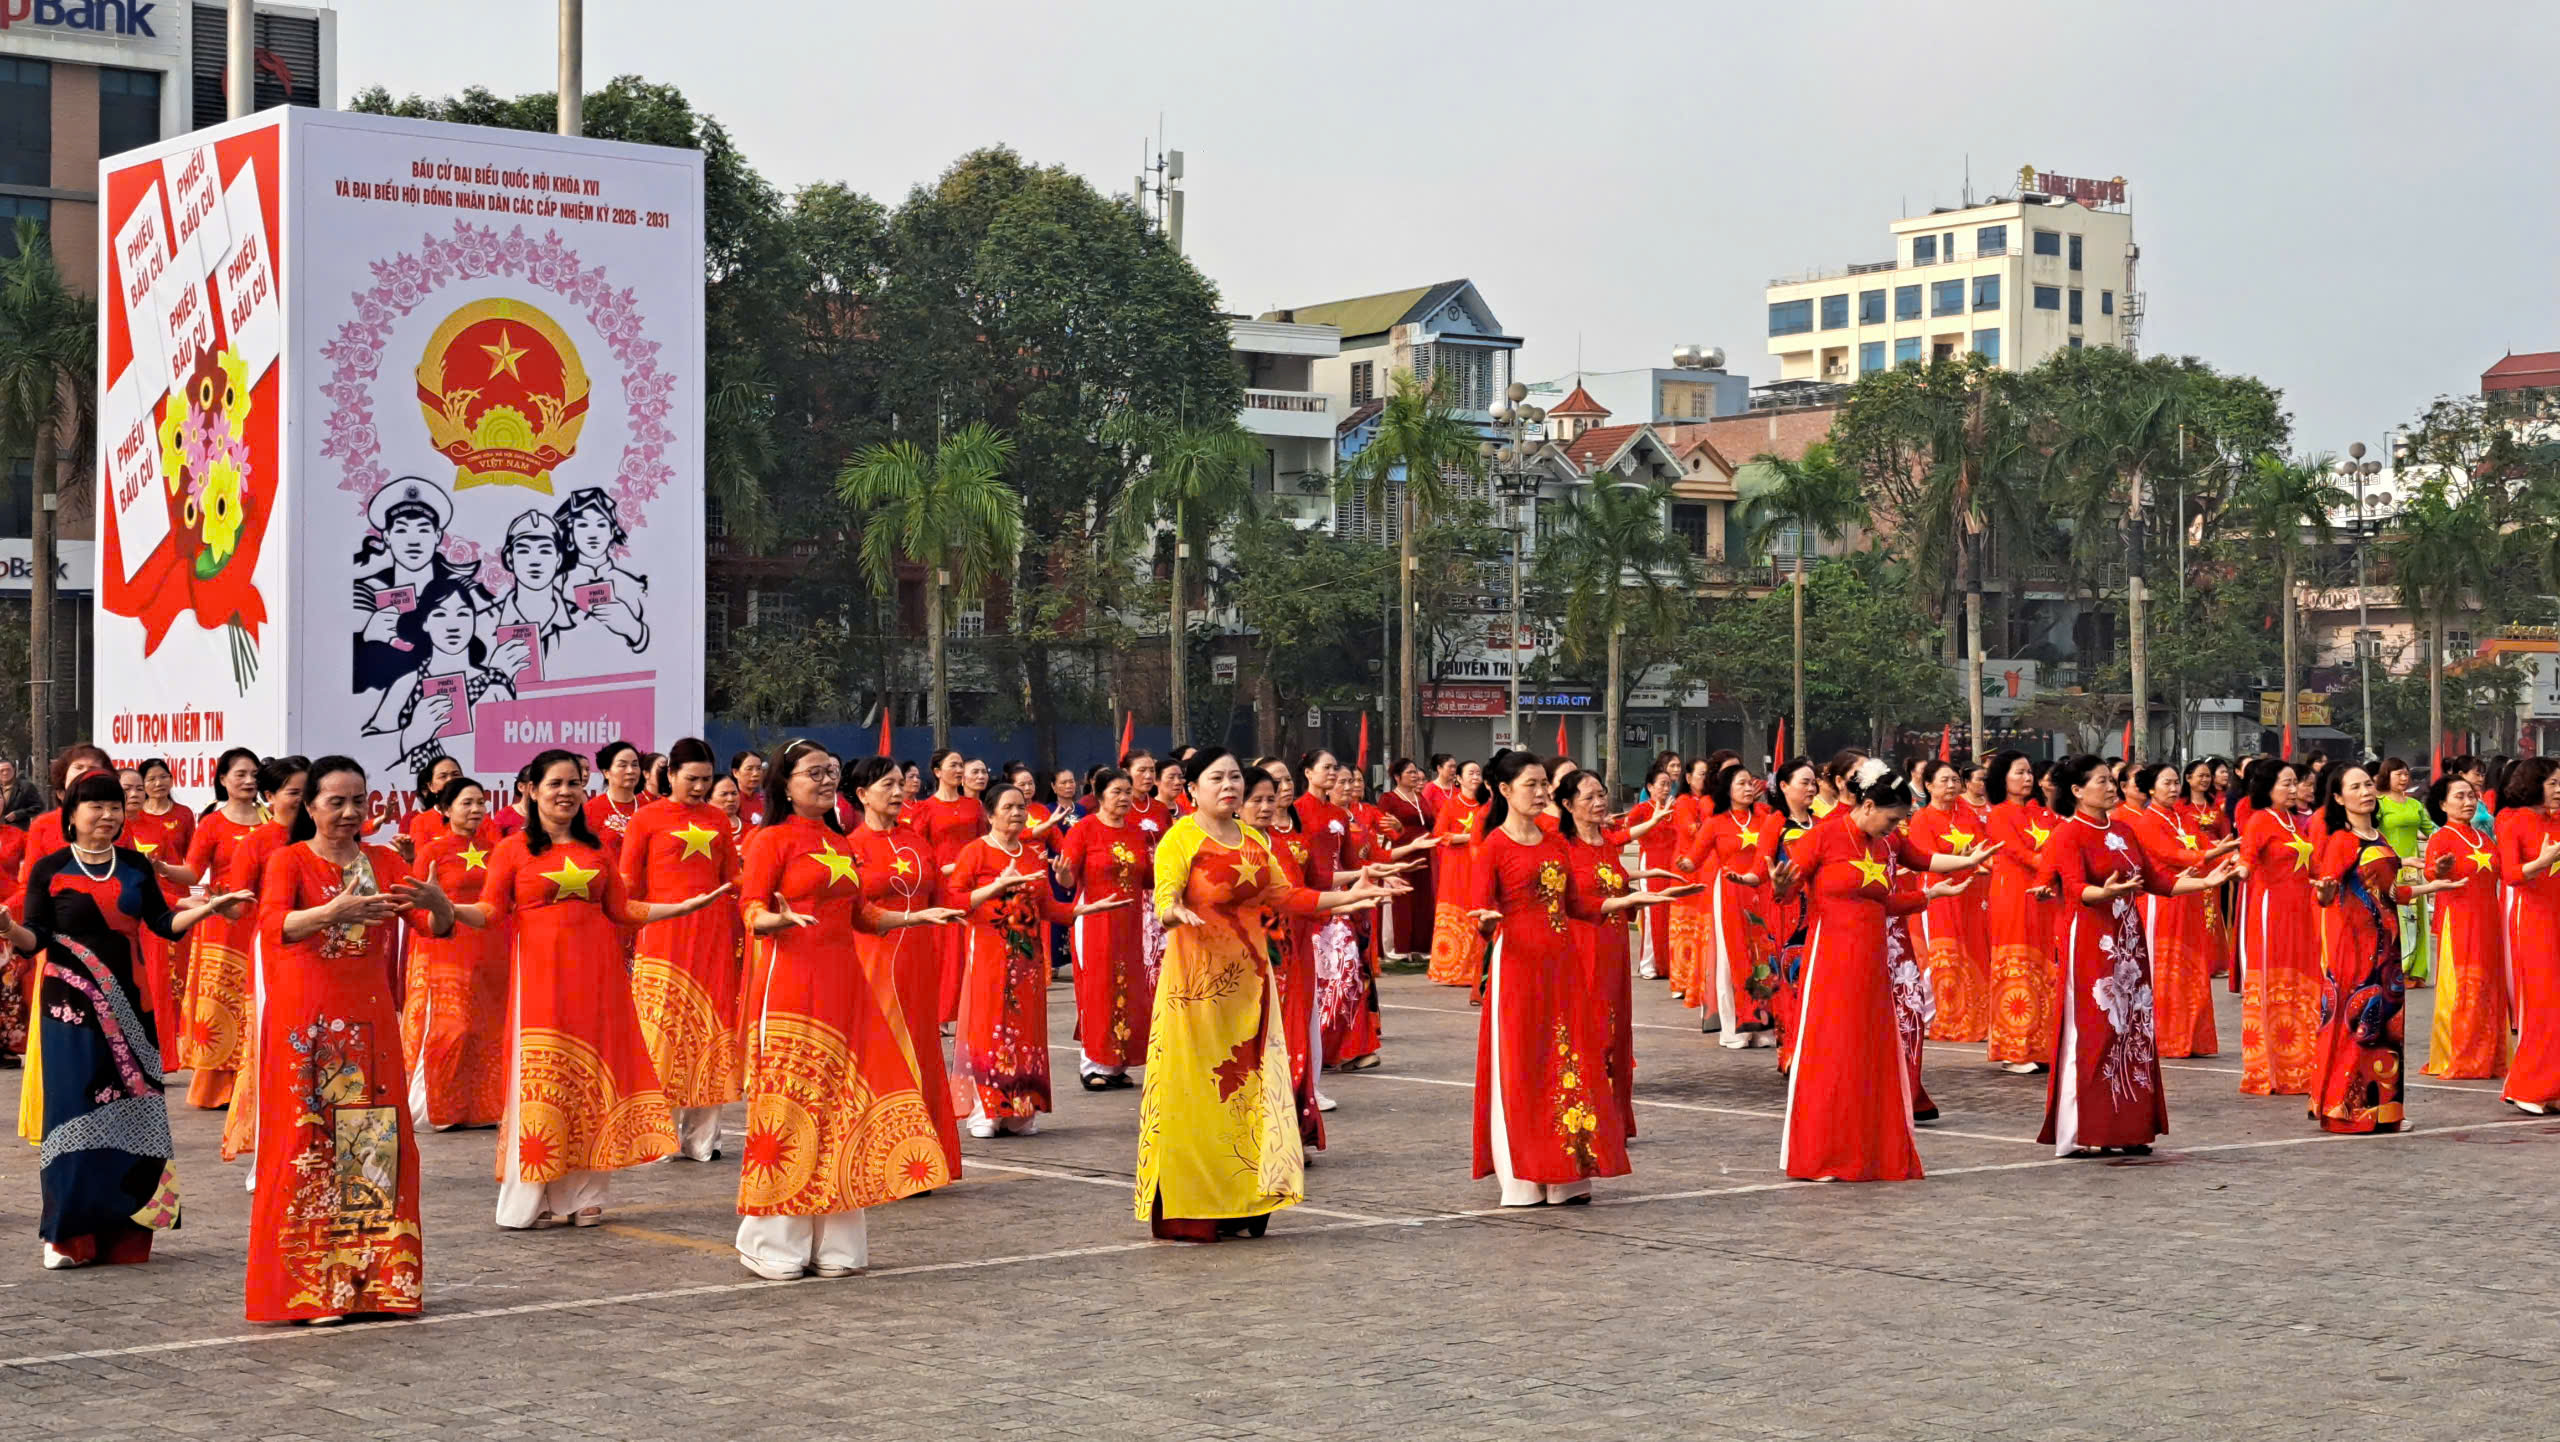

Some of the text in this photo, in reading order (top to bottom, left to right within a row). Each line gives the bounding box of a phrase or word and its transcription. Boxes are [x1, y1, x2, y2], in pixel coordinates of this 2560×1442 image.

[176, 147, 206, 205] PHIẾU
[437, 158, 453, 181] CỬ
[454, 165, 472, 187] ĐẠI
[475, 163, 499, 186] BIỂU
[501, 166, 530, 189] QUỐC
[532, 171, 550, 194] HỘI
[552, 174, 580, 194] KHÓA
[583, 179, 600, 196] XVI
[335, 177, 350, 197] VÀ
[352, 181, 371, 203] ĐẠI
[374, 178, 399, 201] BIỂU
[402, 184, 420, 207] HỘI
[423, 184, 453, 207] ĐỒNG
[455, 190, 486, 211] NHÂN
[488, 192, 510, 213] DÂN
[513, 194, 534, 215] CÁC
[536, 195, 557, 217] CẤP
[560, 201, 594, 224] NHIỆM
[596, 203, 610, 222] KỲ
[612, 208, 637, 225] 2026
[646, 211, 670, 229] 2031
[127, 214, 155, 269] PHIẾU
[227, 233, 257, 292] PHIẾU
[169, 280, 198, 338] PHIẾU
[116, 418, 145, 472] PHIẾU
[479, 457, 529, 470] VIỆT NAM
[112, 702, 224, 747] GỬI TRỌN NIỀM TIN
[1545, 695, 1570, 706] STAR
[1571, 696, 1592, 706] CITY
[503, 714, 622, 744] HÒM PHIẾU
[191, 752, 205, 788] LÁ
